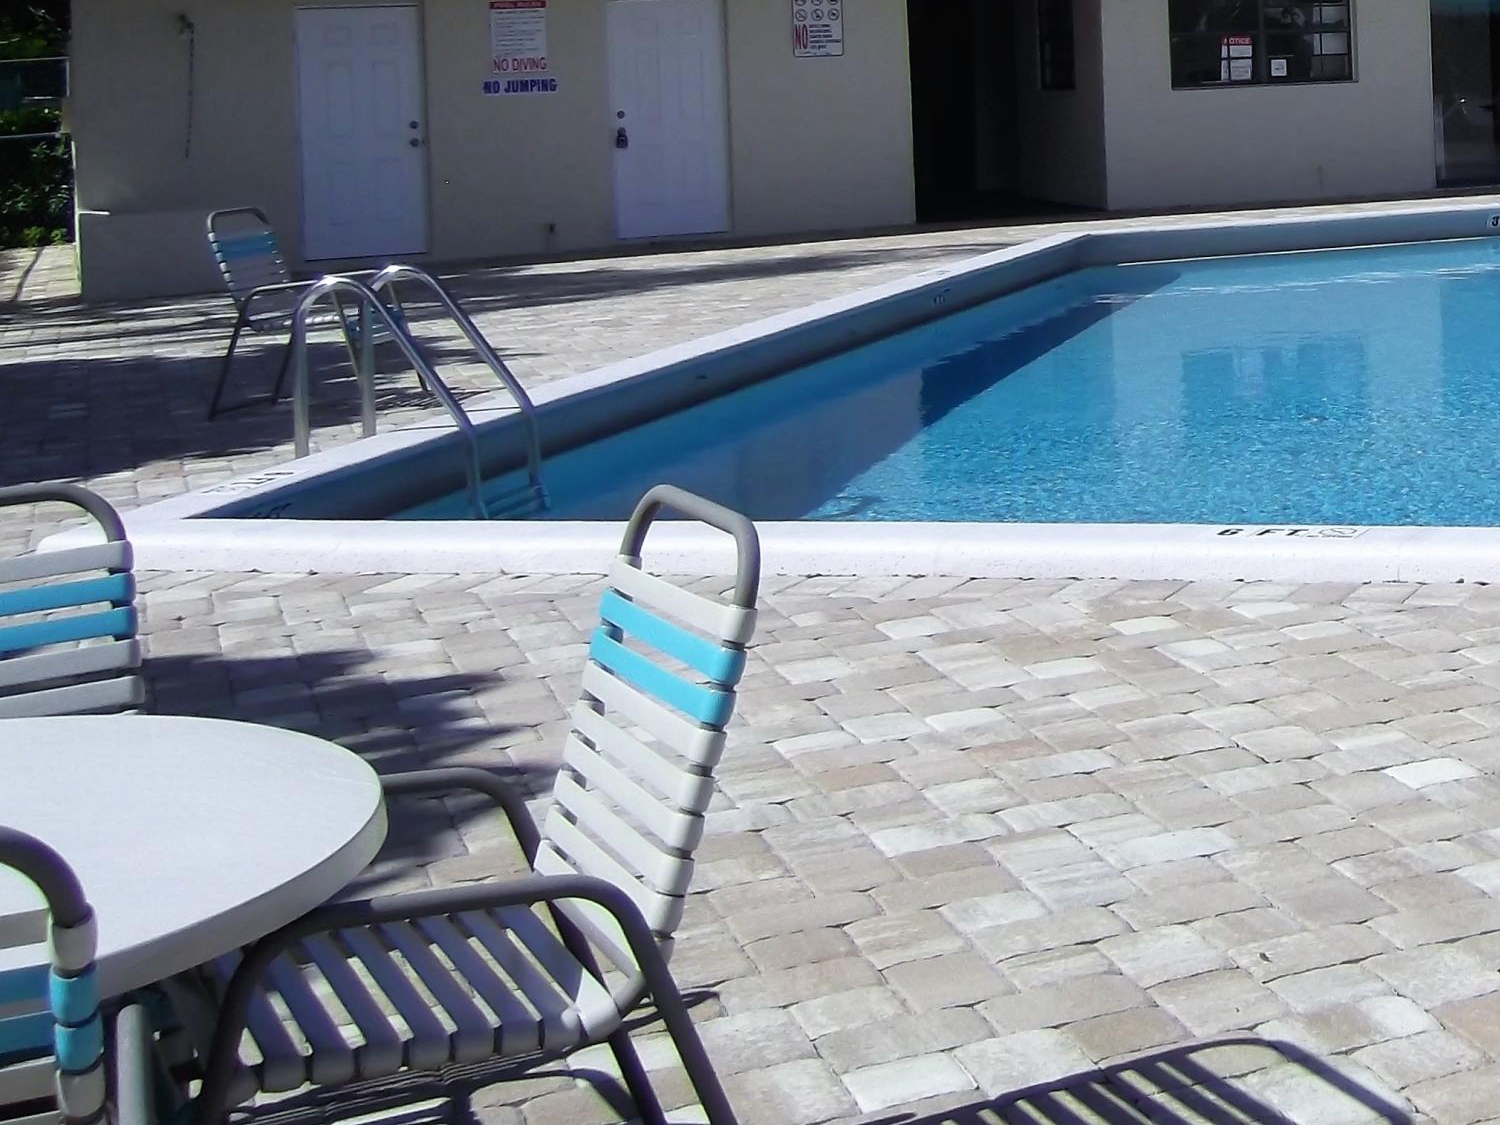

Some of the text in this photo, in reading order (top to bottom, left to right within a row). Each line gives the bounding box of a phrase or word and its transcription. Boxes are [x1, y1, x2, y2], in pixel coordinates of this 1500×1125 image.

[795, 24, 808, 50] NO
[493, 56, 547, 71] NO DIVING
[483, 78, 557, 94] NO JUMPING
